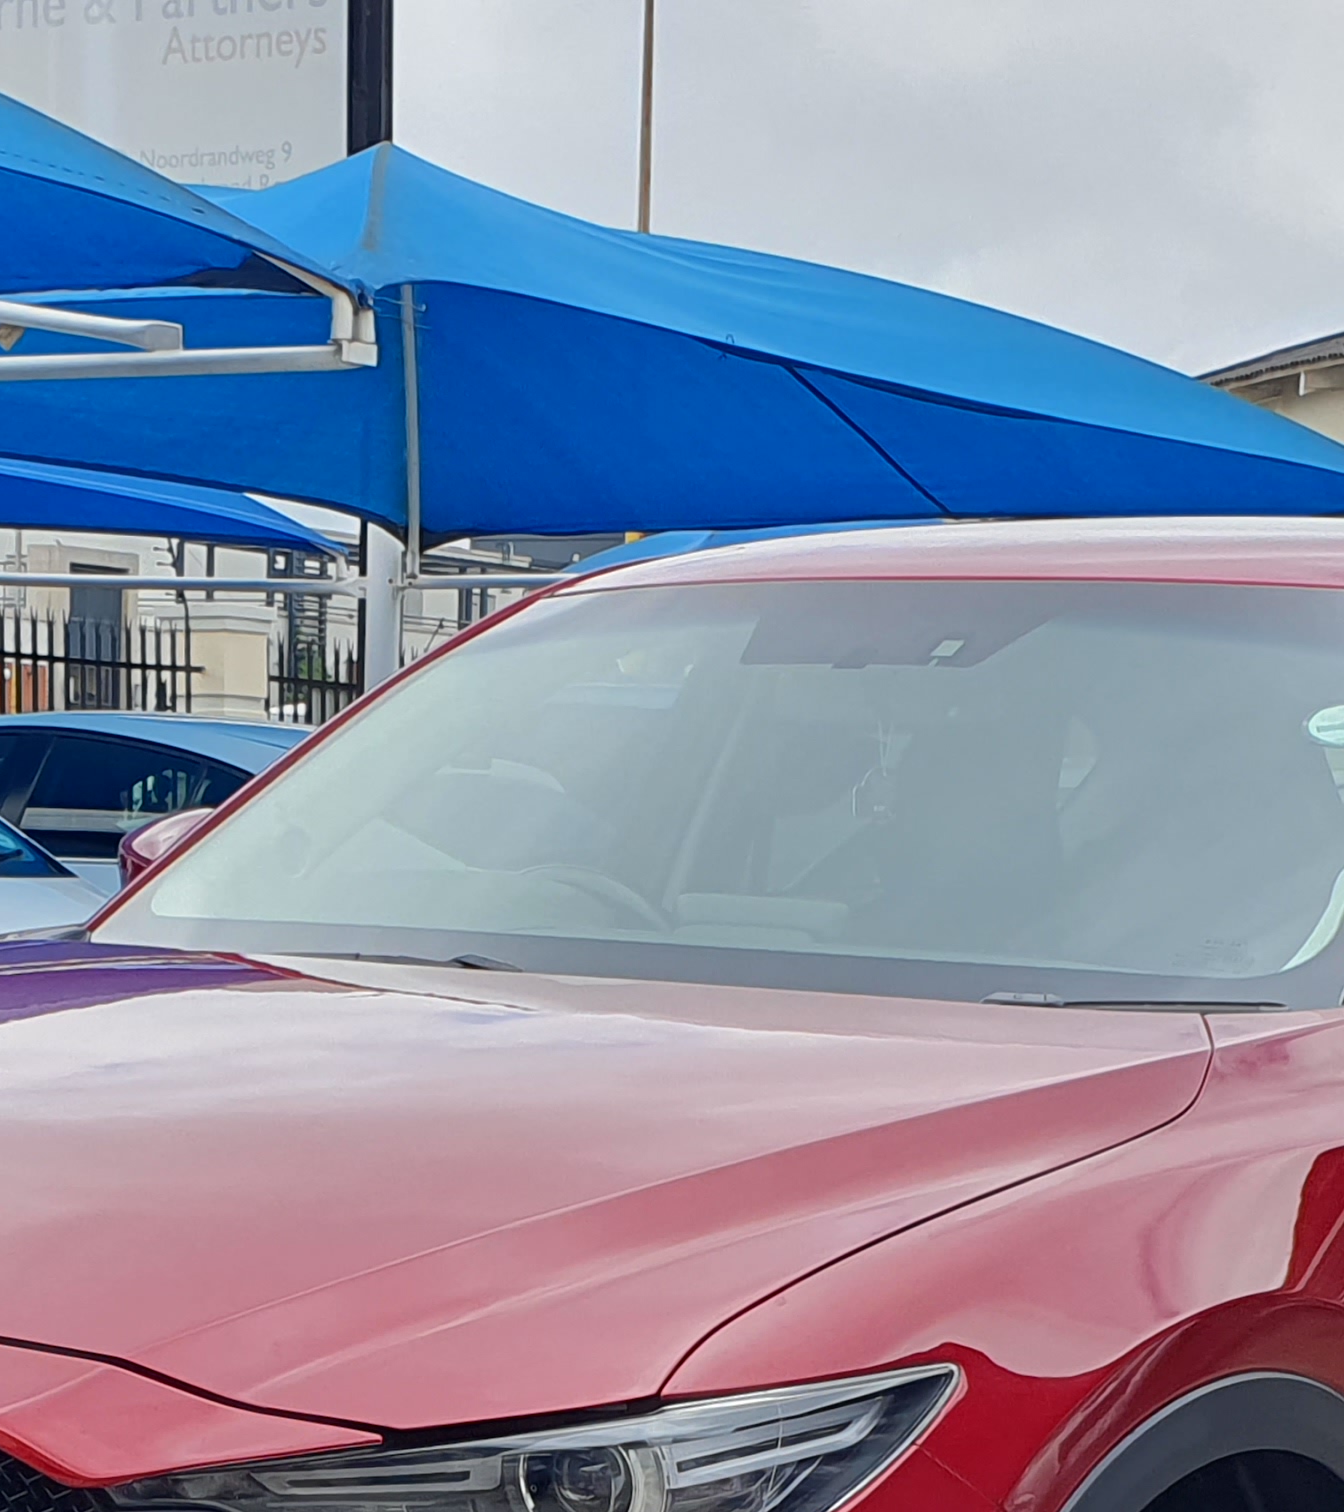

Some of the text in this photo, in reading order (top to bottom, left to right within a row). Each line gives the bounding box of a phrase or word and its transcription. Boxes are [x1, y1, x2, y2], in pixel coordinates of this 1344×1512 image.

[162, 26, 327, 69] Attorneys
[140, 140, 293, 170] Noordrandweg 9
